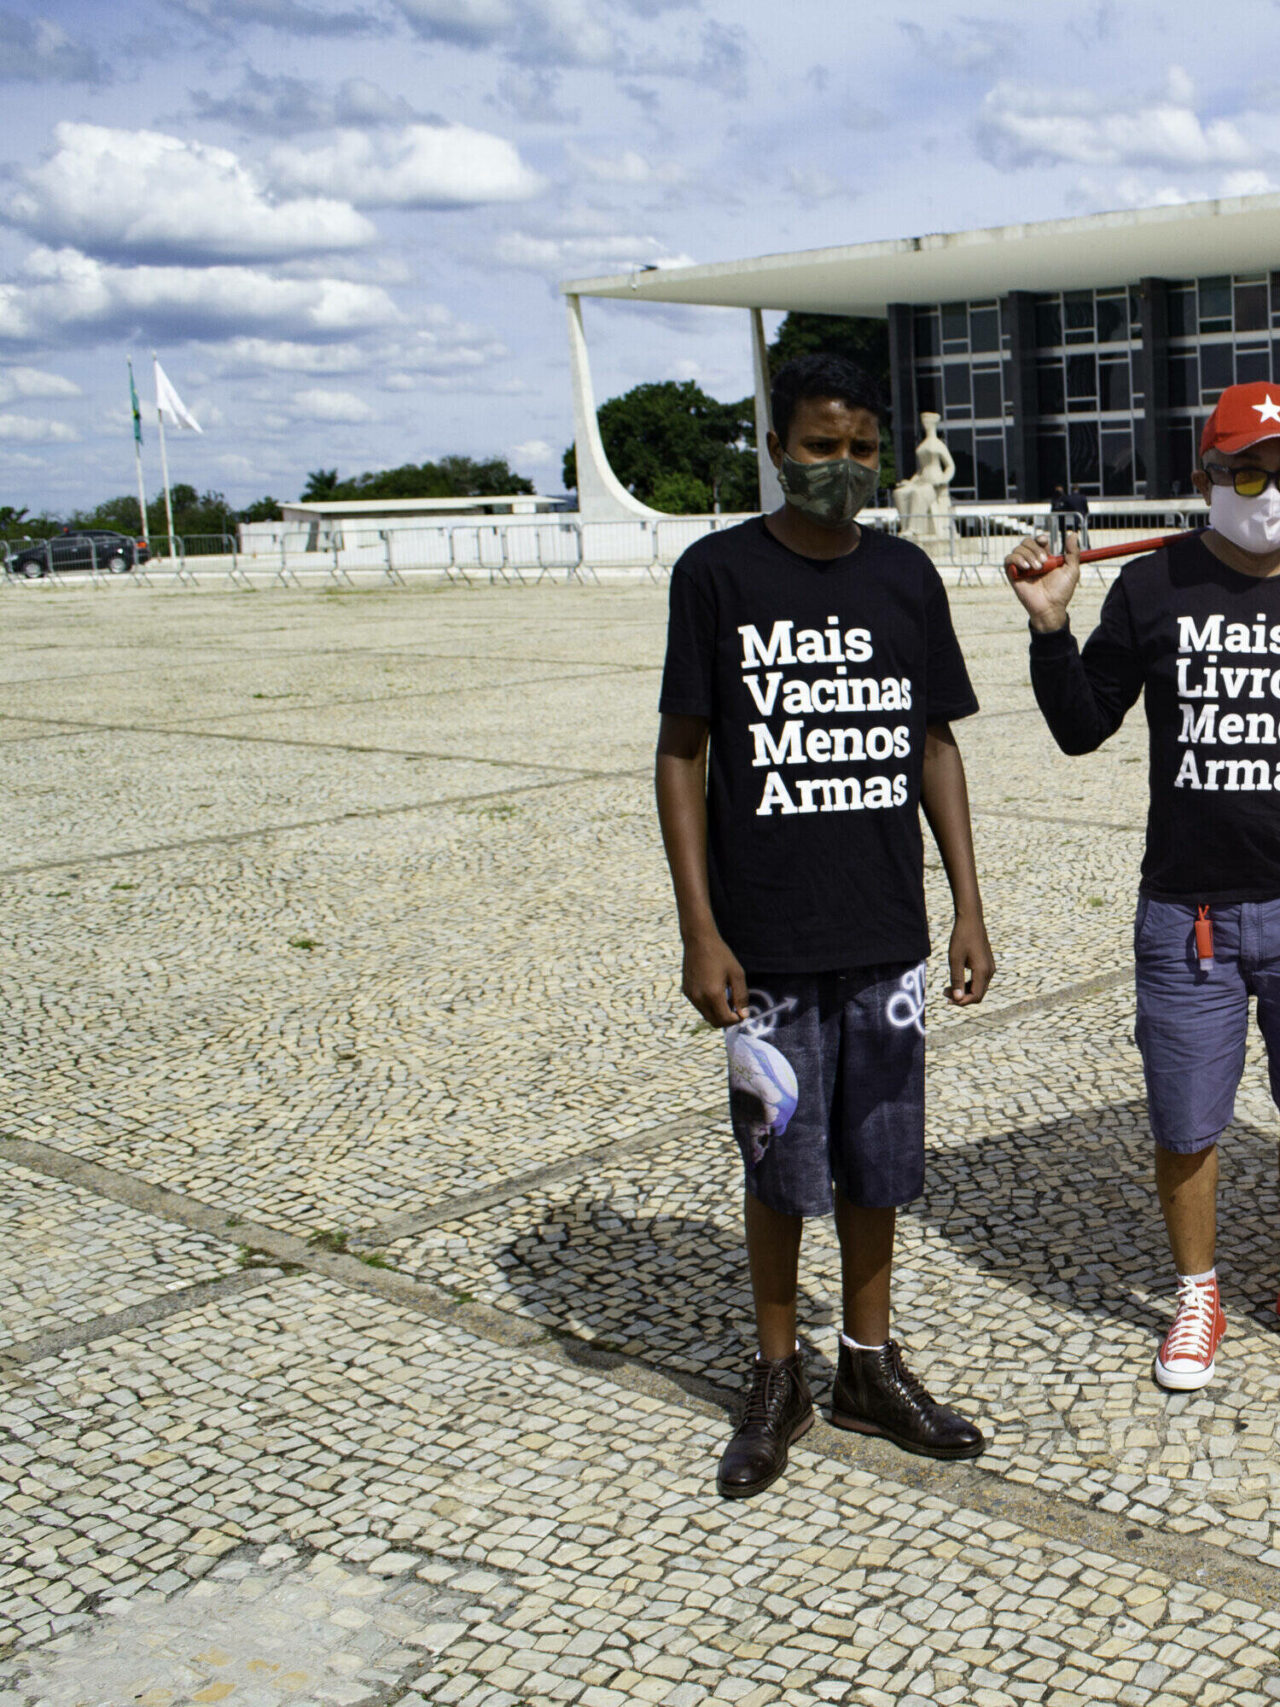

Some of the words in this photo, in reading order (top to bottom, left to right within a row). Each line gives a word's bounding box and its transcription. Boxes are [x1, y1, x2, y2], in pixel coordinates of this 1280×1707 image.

[737, 615, 873, 669] Mais
[742, 666, 912, 716] Vacinas
[748, 720, 911, 767] Menos
[756, 771, 908, 816] Armas
